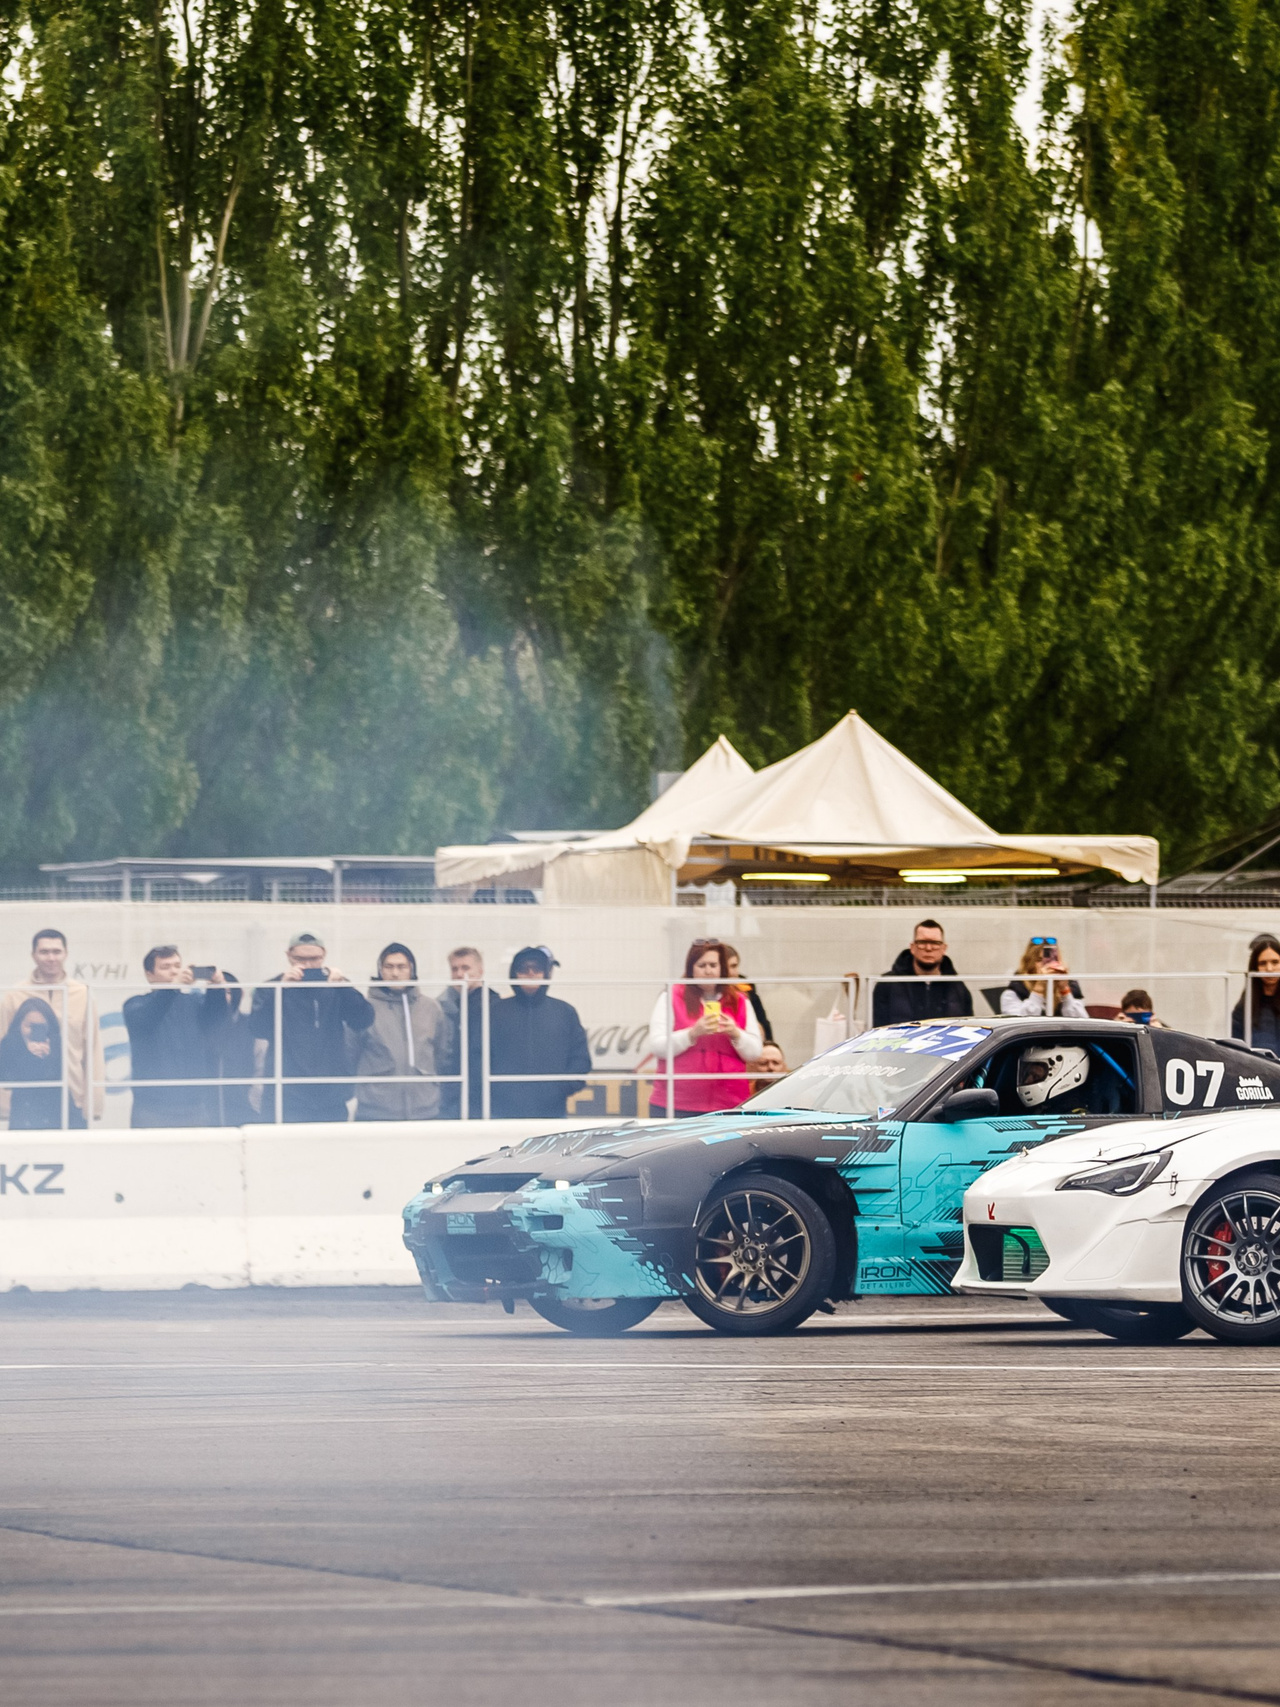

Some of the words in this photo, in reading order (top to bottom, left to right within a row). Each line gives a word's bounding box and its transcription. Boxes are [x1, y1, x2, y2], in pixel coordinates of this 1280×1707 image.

[1165, 1058, 1225, 1108] 07
[1235, 1086, 1274, 1101] GORILLA
[0, 1163, 65, 1195] KZ
[861, 1265, 912, 1279] IRON
[860, 1281, 912, 1290] DETAILING
